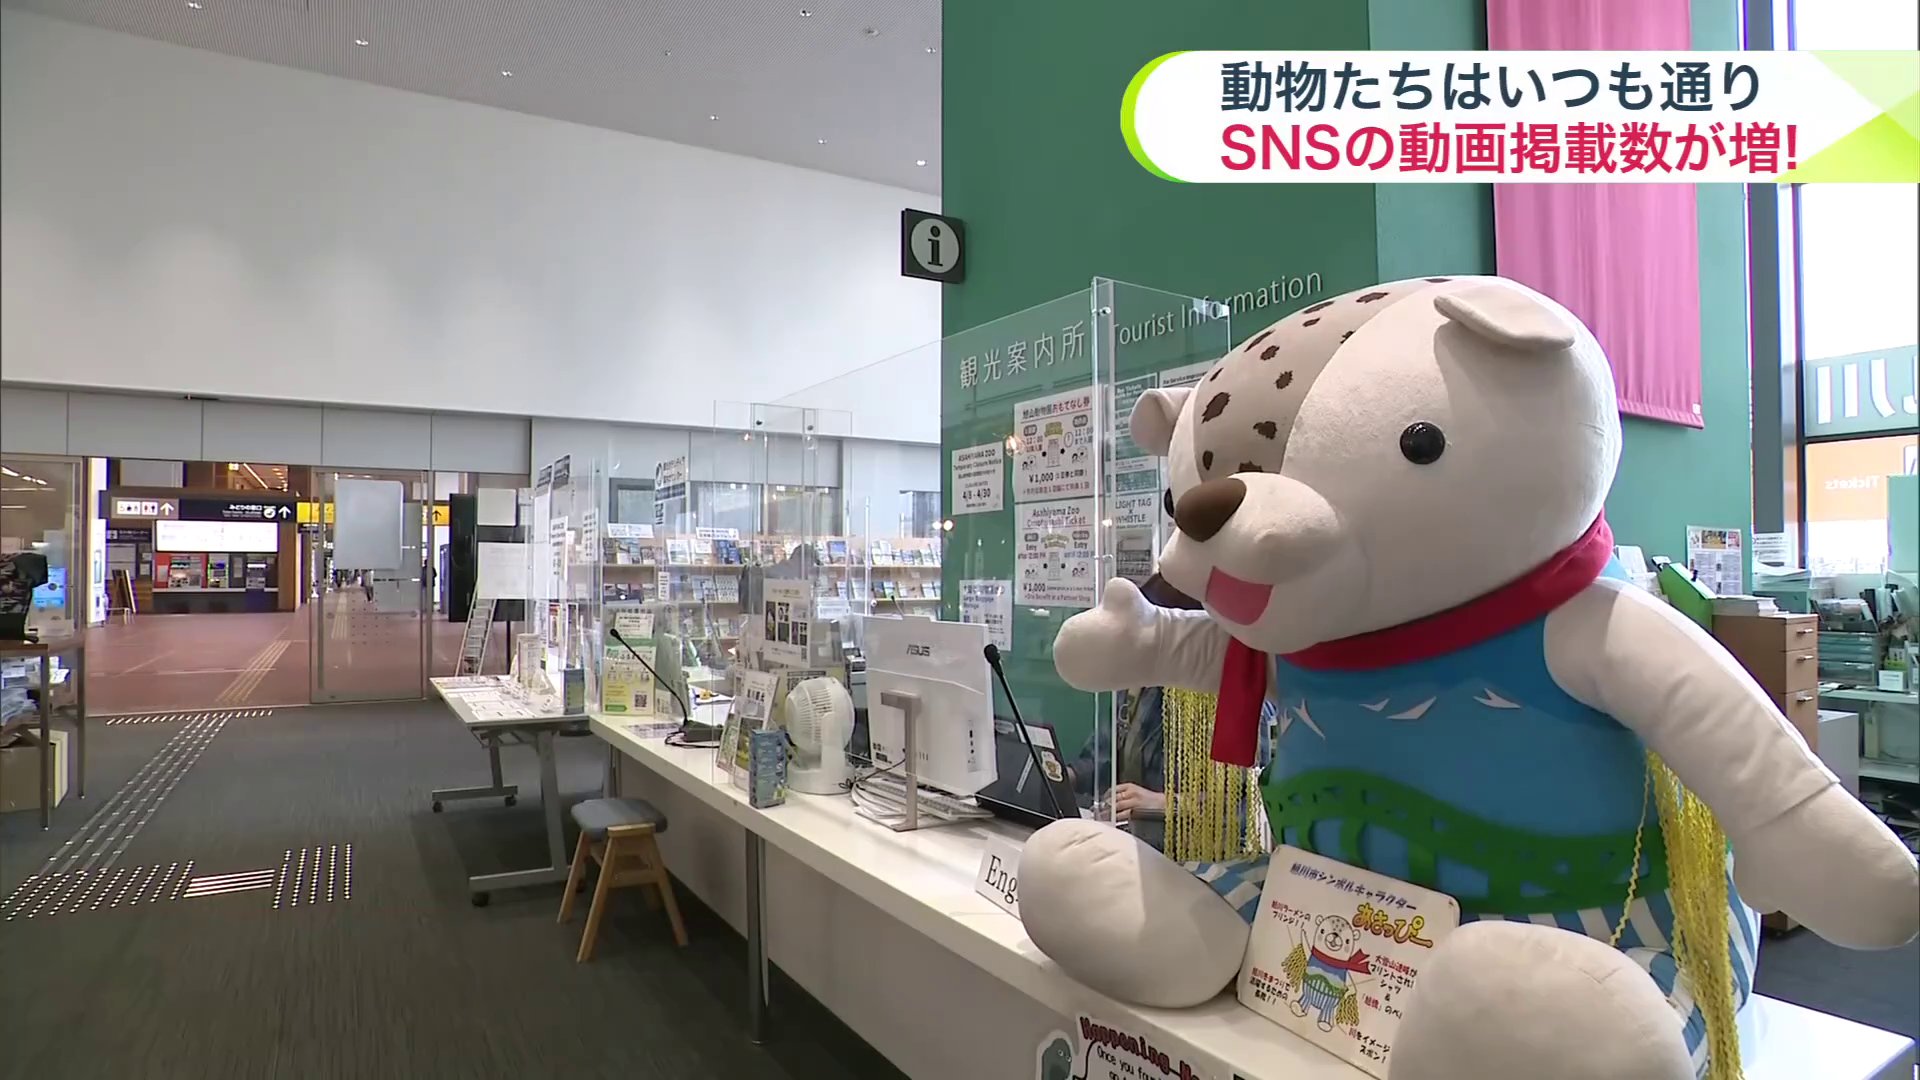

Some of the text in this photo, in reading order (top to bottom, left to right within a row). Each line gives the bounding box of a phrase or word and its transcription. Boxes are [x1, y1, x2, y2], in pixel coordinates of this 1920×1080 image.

[1182, 271, 1323, 329] Information
[960, 320, 1085, 389] 観光案内所
[906, 644, 931, 657] ASUS
[985, 854, 1019, 905] Eng
